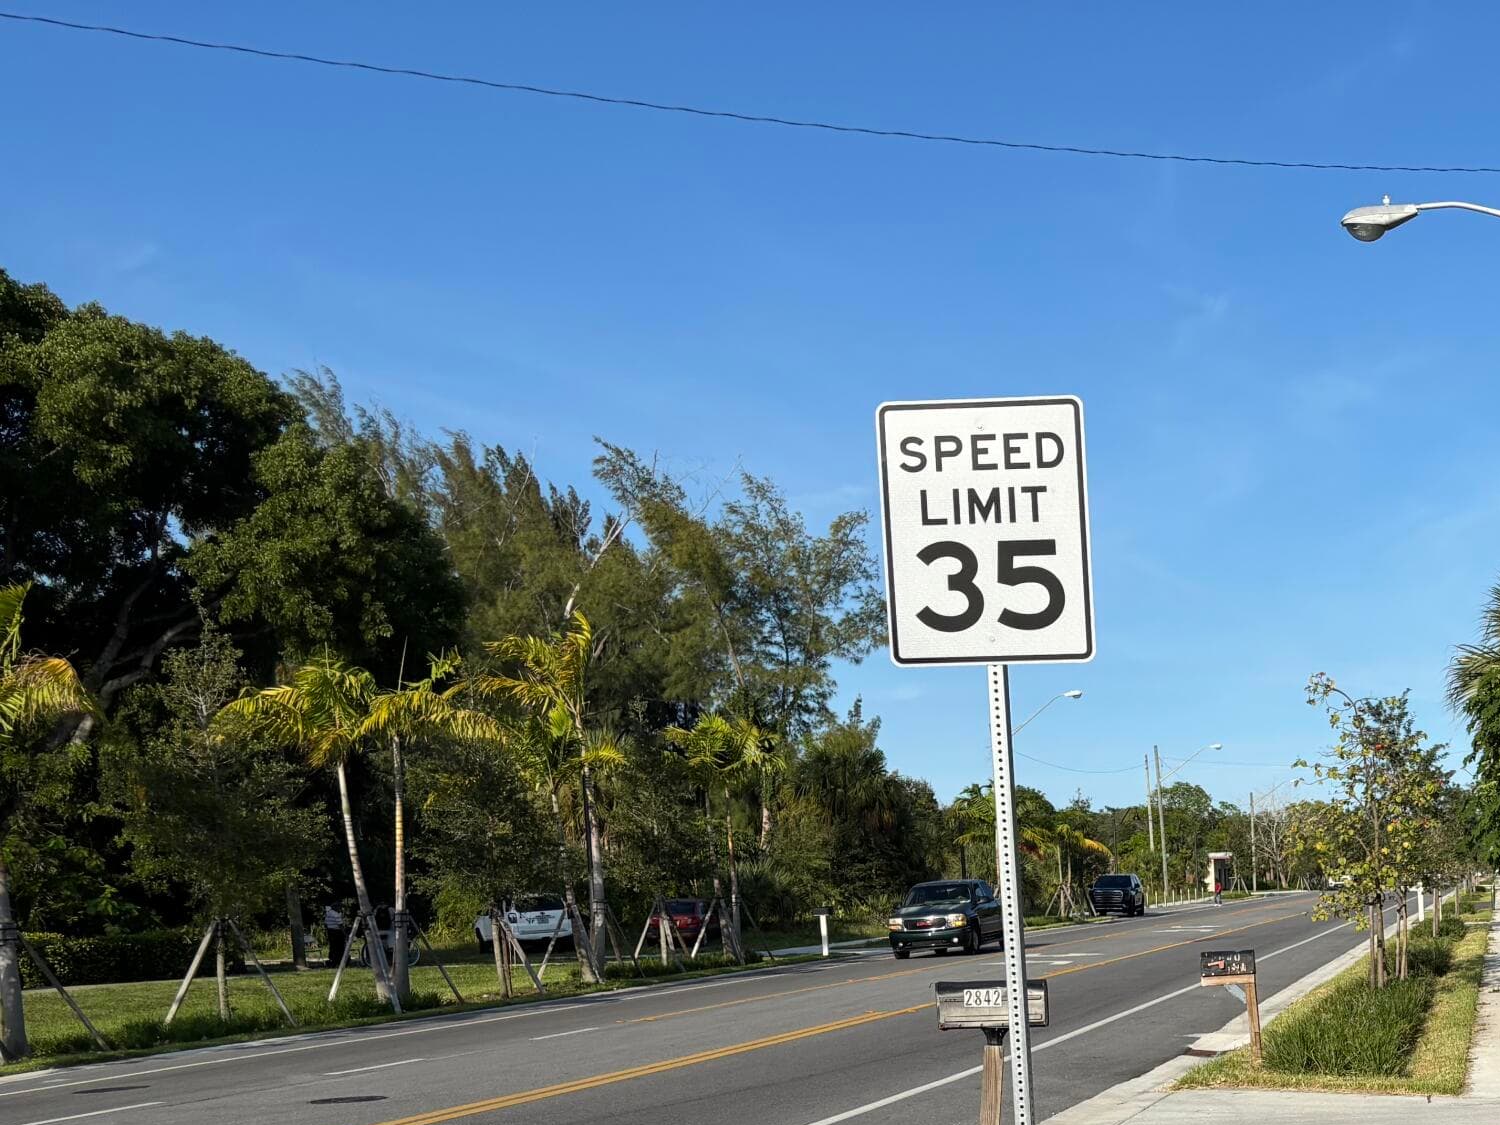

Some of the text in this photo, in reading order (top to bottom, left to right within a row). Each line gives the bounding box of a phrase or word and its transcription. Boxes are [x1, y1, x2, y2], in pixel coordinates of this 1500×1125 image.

[900, 432, 1064, 473] SPEED
[920, 485, 1047, 526] LIMIT
[916, 539, 1065, 632] 35
[965, 990, 1000, 1006] 2842
